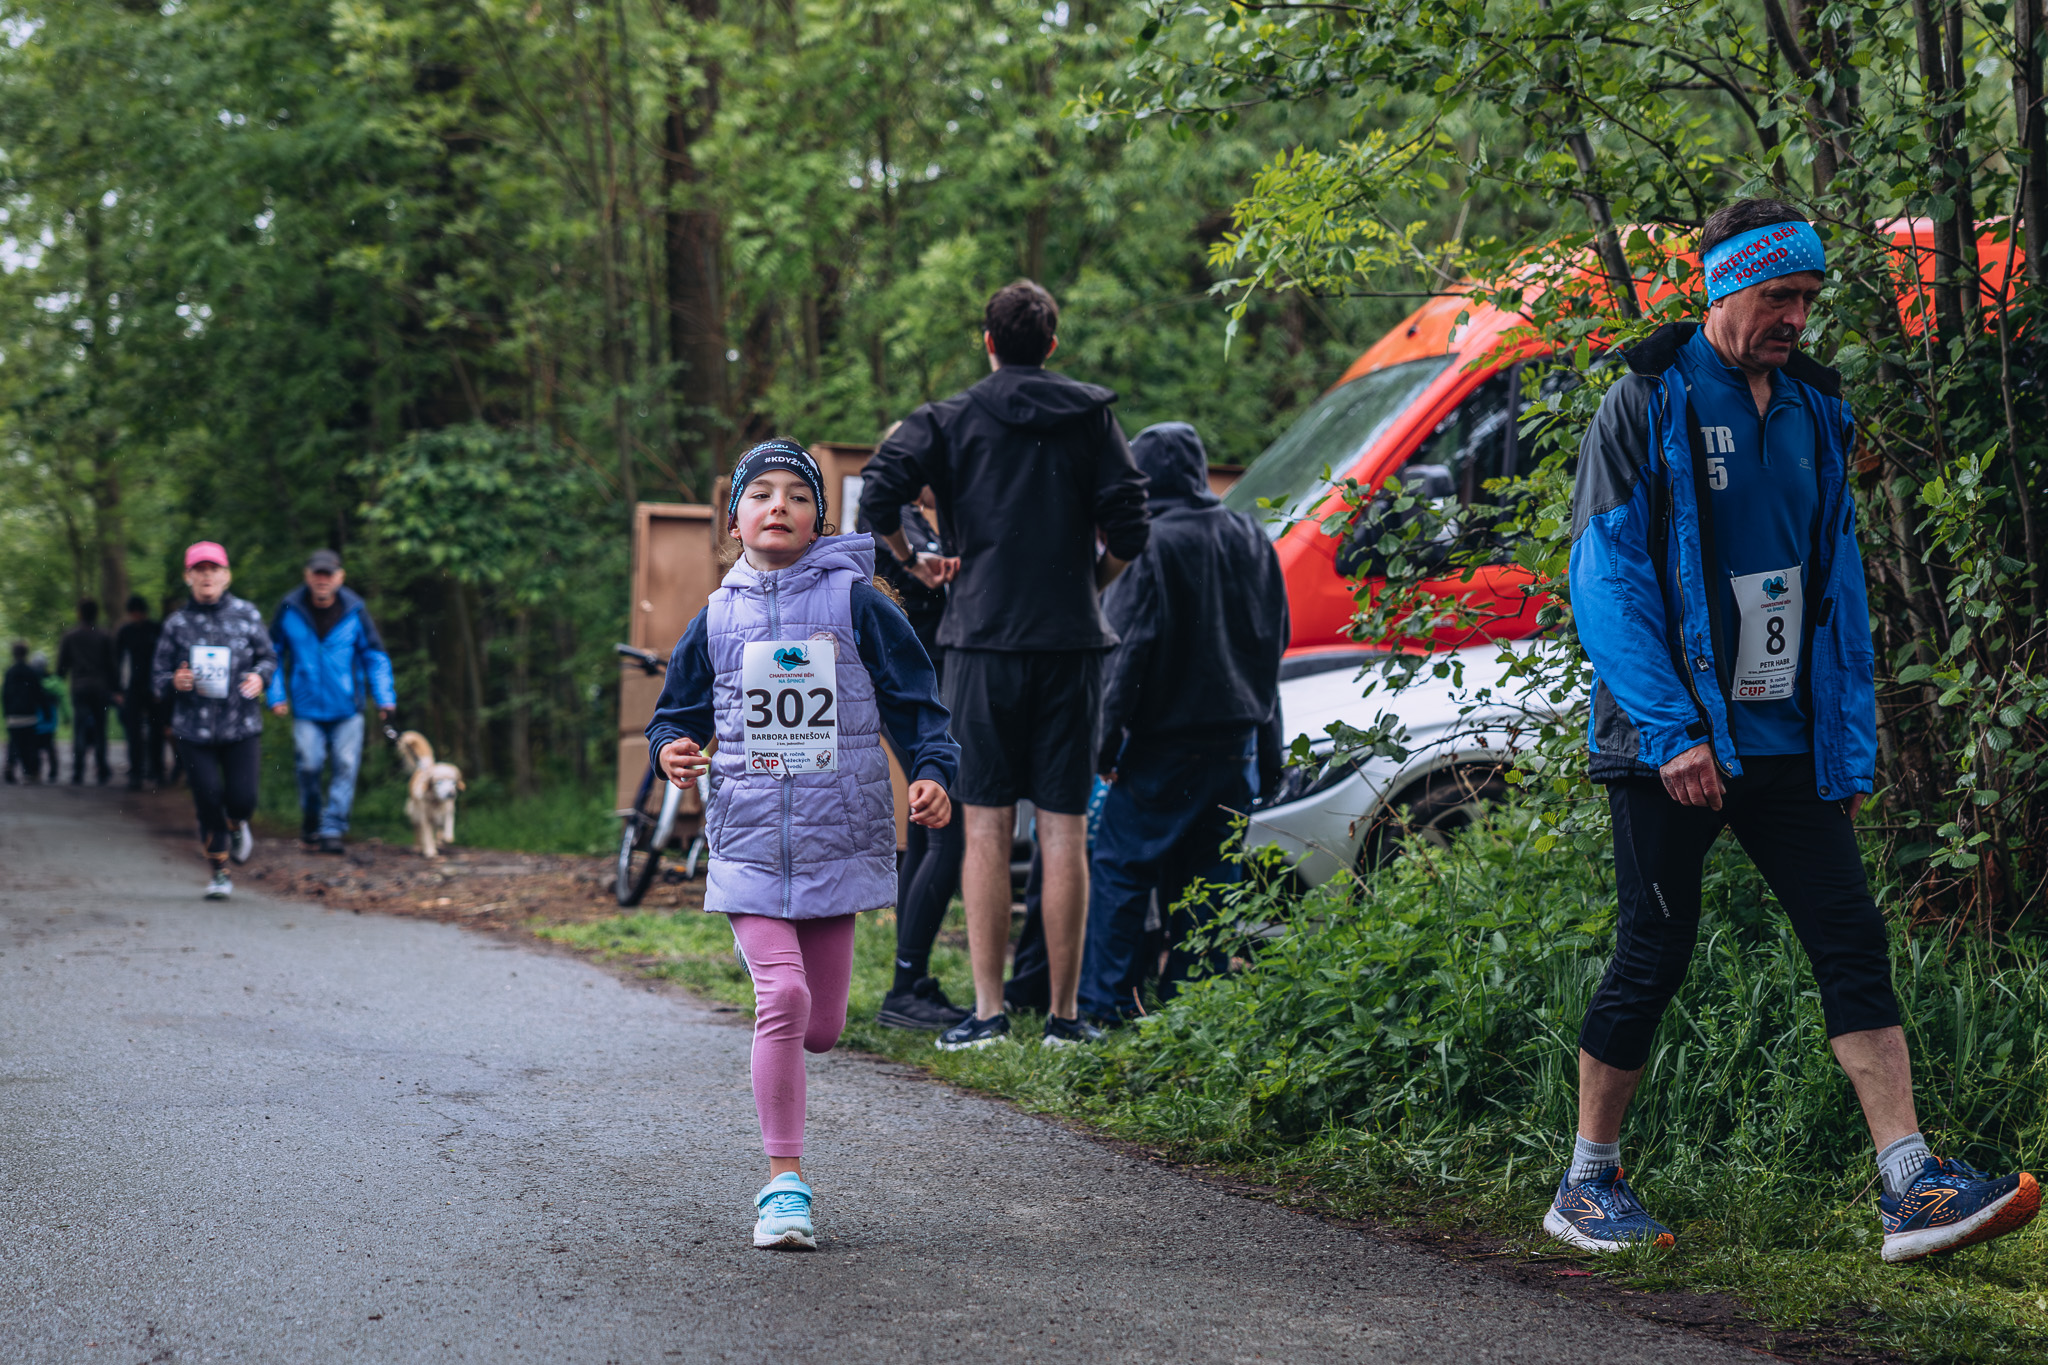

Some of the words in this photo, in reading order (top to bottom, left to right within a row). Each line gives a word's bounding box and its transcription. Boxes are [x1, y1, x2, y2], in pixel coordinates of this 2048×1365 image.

[1711, 234, 1771, 282] JEŠTĚTICKÝ
[1771, 225, 1799, 242] BĚH
[1735, 247, 1789, 283] POCHOD
[1699, 426, 1736, 454] TR
[1706, 457, 1729, 491] 5
[1765, 616, 1786, 656] 8
[1759, 661, 1775, 669] PETR
[1775, 658, 1790, 666] HABR
[745, 687, 835, 728] 302
[1738, 686, 1766, 696] CUP
[751, 733, 788, 741] BARBORA
[789, 731, 831, 741] BENEŠOVÁ
